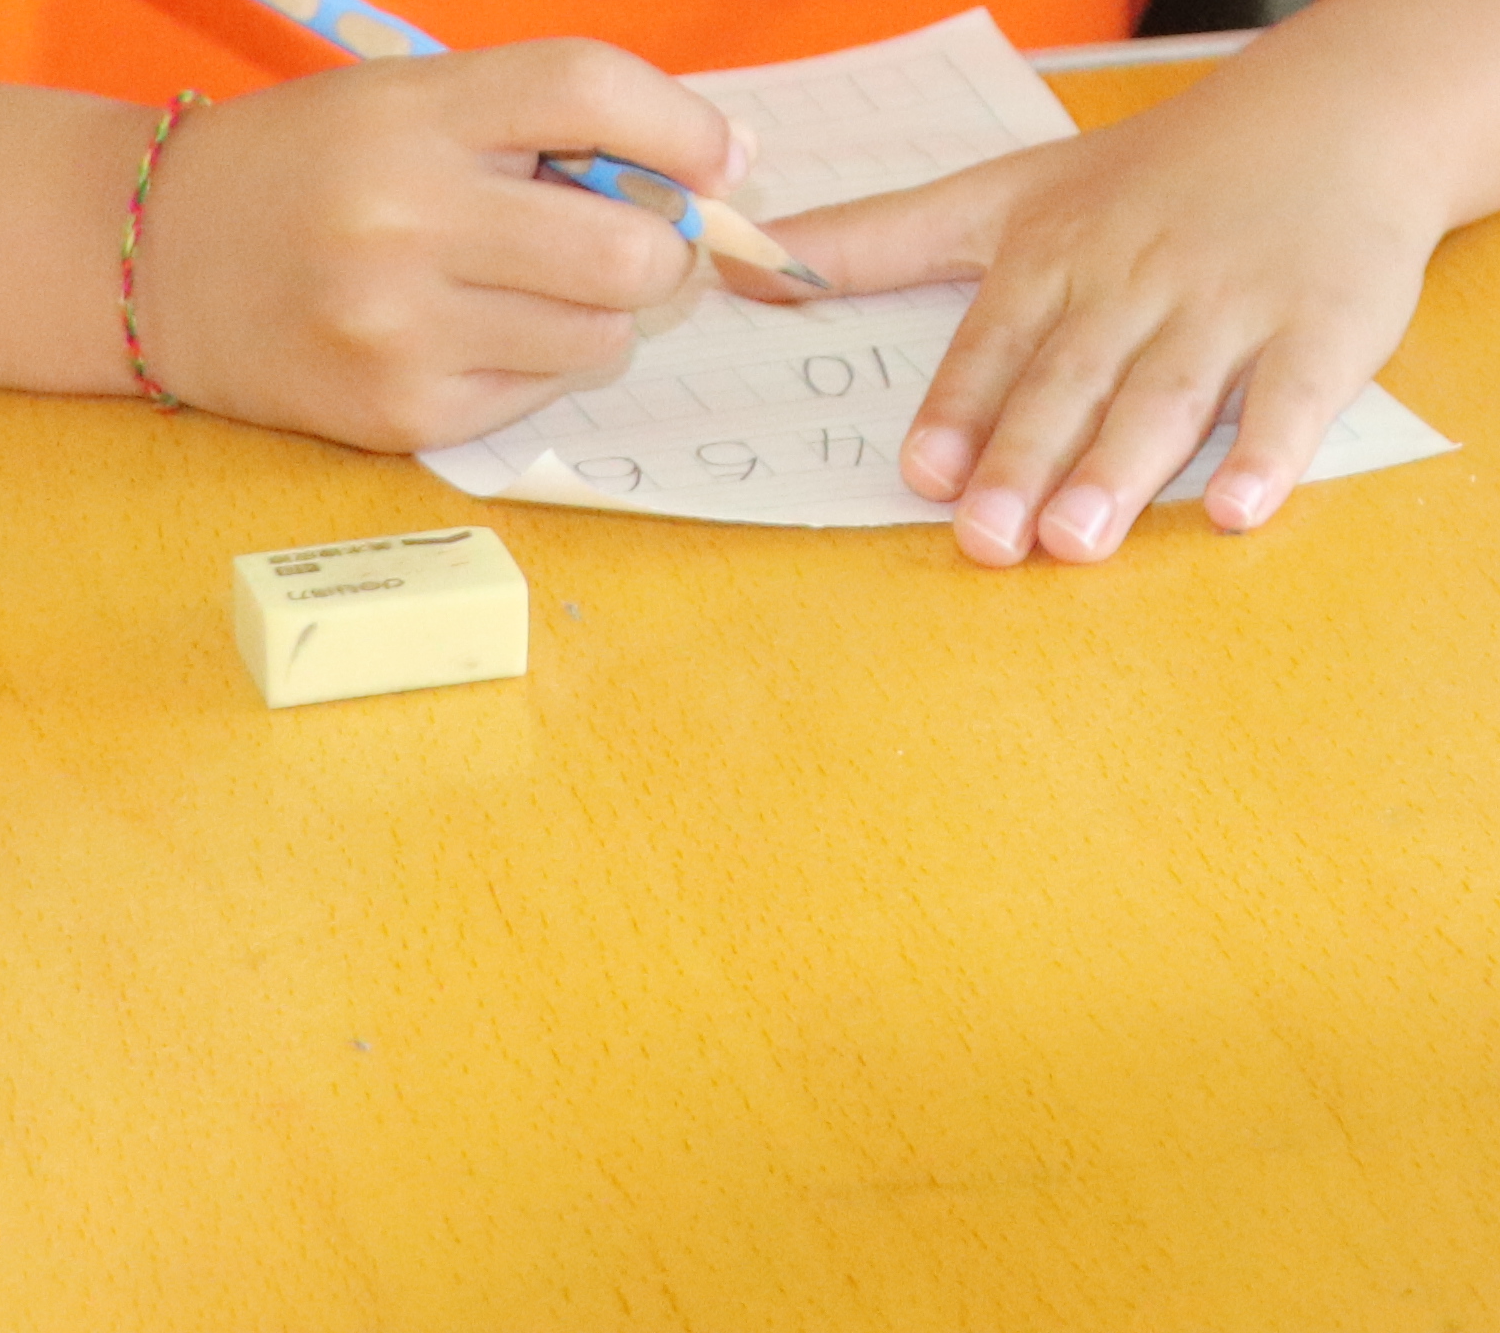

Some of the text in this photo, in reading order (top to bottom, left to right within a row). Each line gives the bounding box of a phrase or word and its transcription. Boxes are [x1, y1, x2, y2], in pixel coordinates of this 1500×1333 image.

[803, 346, 890, 398] 10
[807, 428, 864, 467] 4
[574, 457, 642, 492] 6
